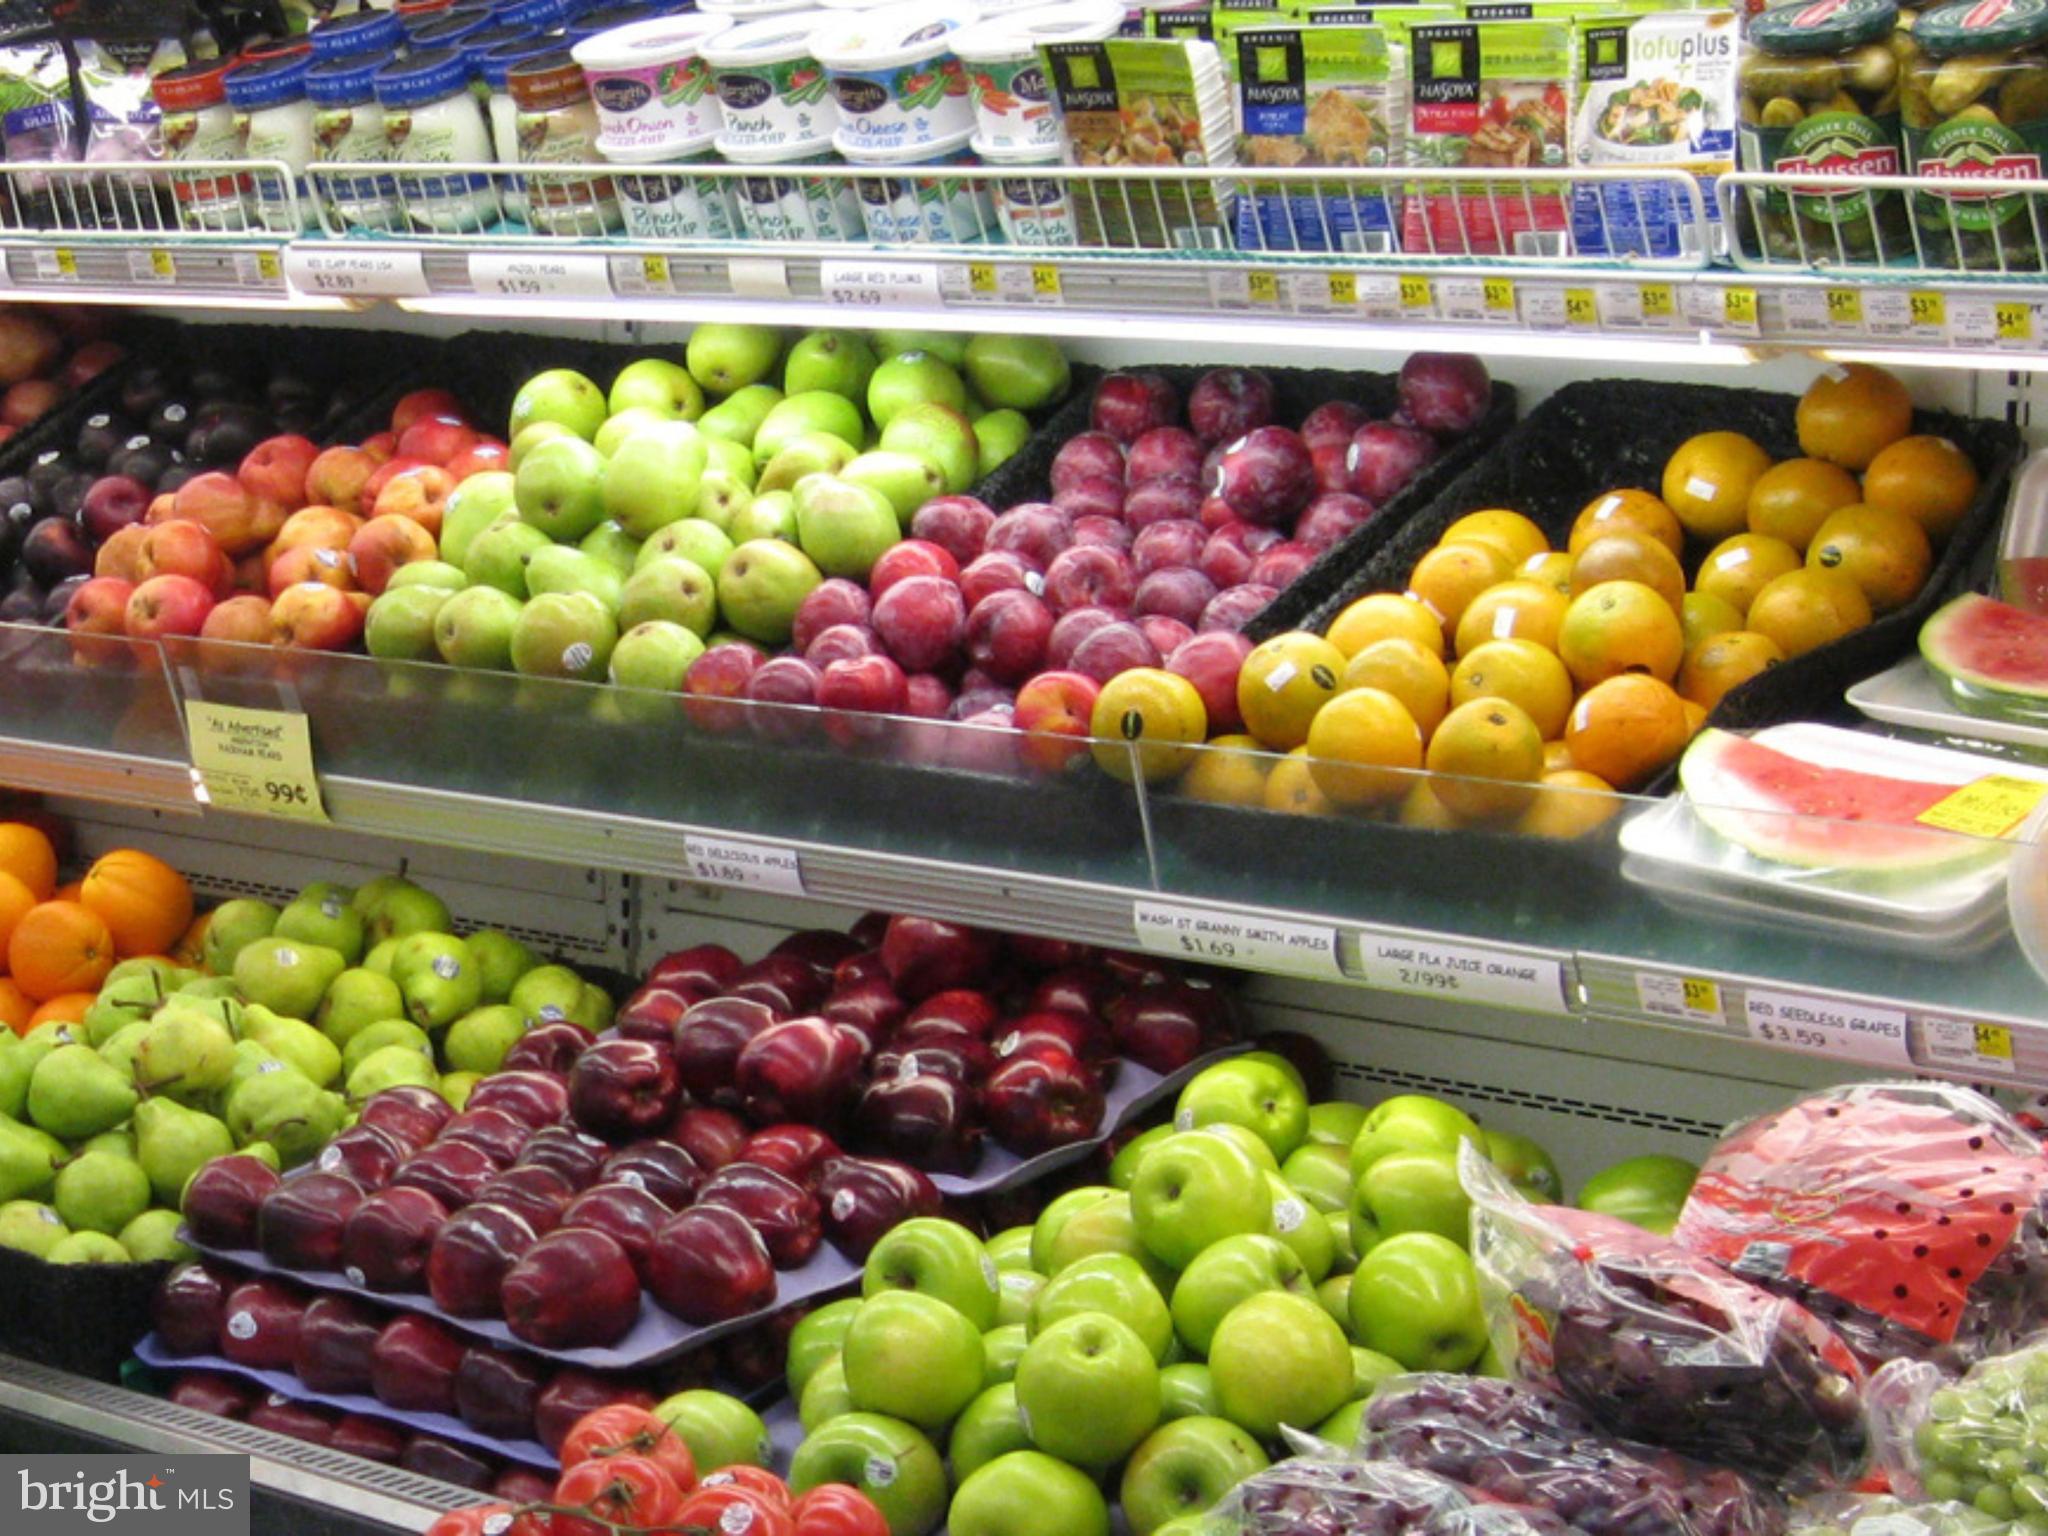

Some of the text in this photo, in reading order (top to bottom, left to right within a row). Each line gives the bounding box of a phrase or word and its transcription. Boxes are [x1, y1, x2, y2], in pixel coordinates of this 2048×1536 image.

[1154, 14, 1207, 23] ORGANIC
[1314, 13, 1368, 23] ORGANIC
[1472, 8, 1528, 17] ORGANIC
[1243, 33, 1297, 43] ORGANIC
[1418, 29, 1473, 39] ORGANIC
[1633, 32, 1730, 64] tofuplus
[1065, 91, 1115, 108] NASOYA
[1248, 87, 1300, 104] NASOYA
[1419, 83, 1475, 102] NASOYA
[834, 271, 865, 284] LARGE
[867, 272, 887, 284] RED
[264, 780, 309, 806] 99¢
[1138, 911, 1331, 951] WASH ST GRANNY SMITH APPLES
[1180, 935, 1236, 958] $1.69
[1377, 945, 1539, 983] LARGE FLA JUICE ORANGE
[1747, 1000, 1902, 1039] RED SEEDLESS GRAPES
[1758, 1021, 1828, 1048] $3.59
